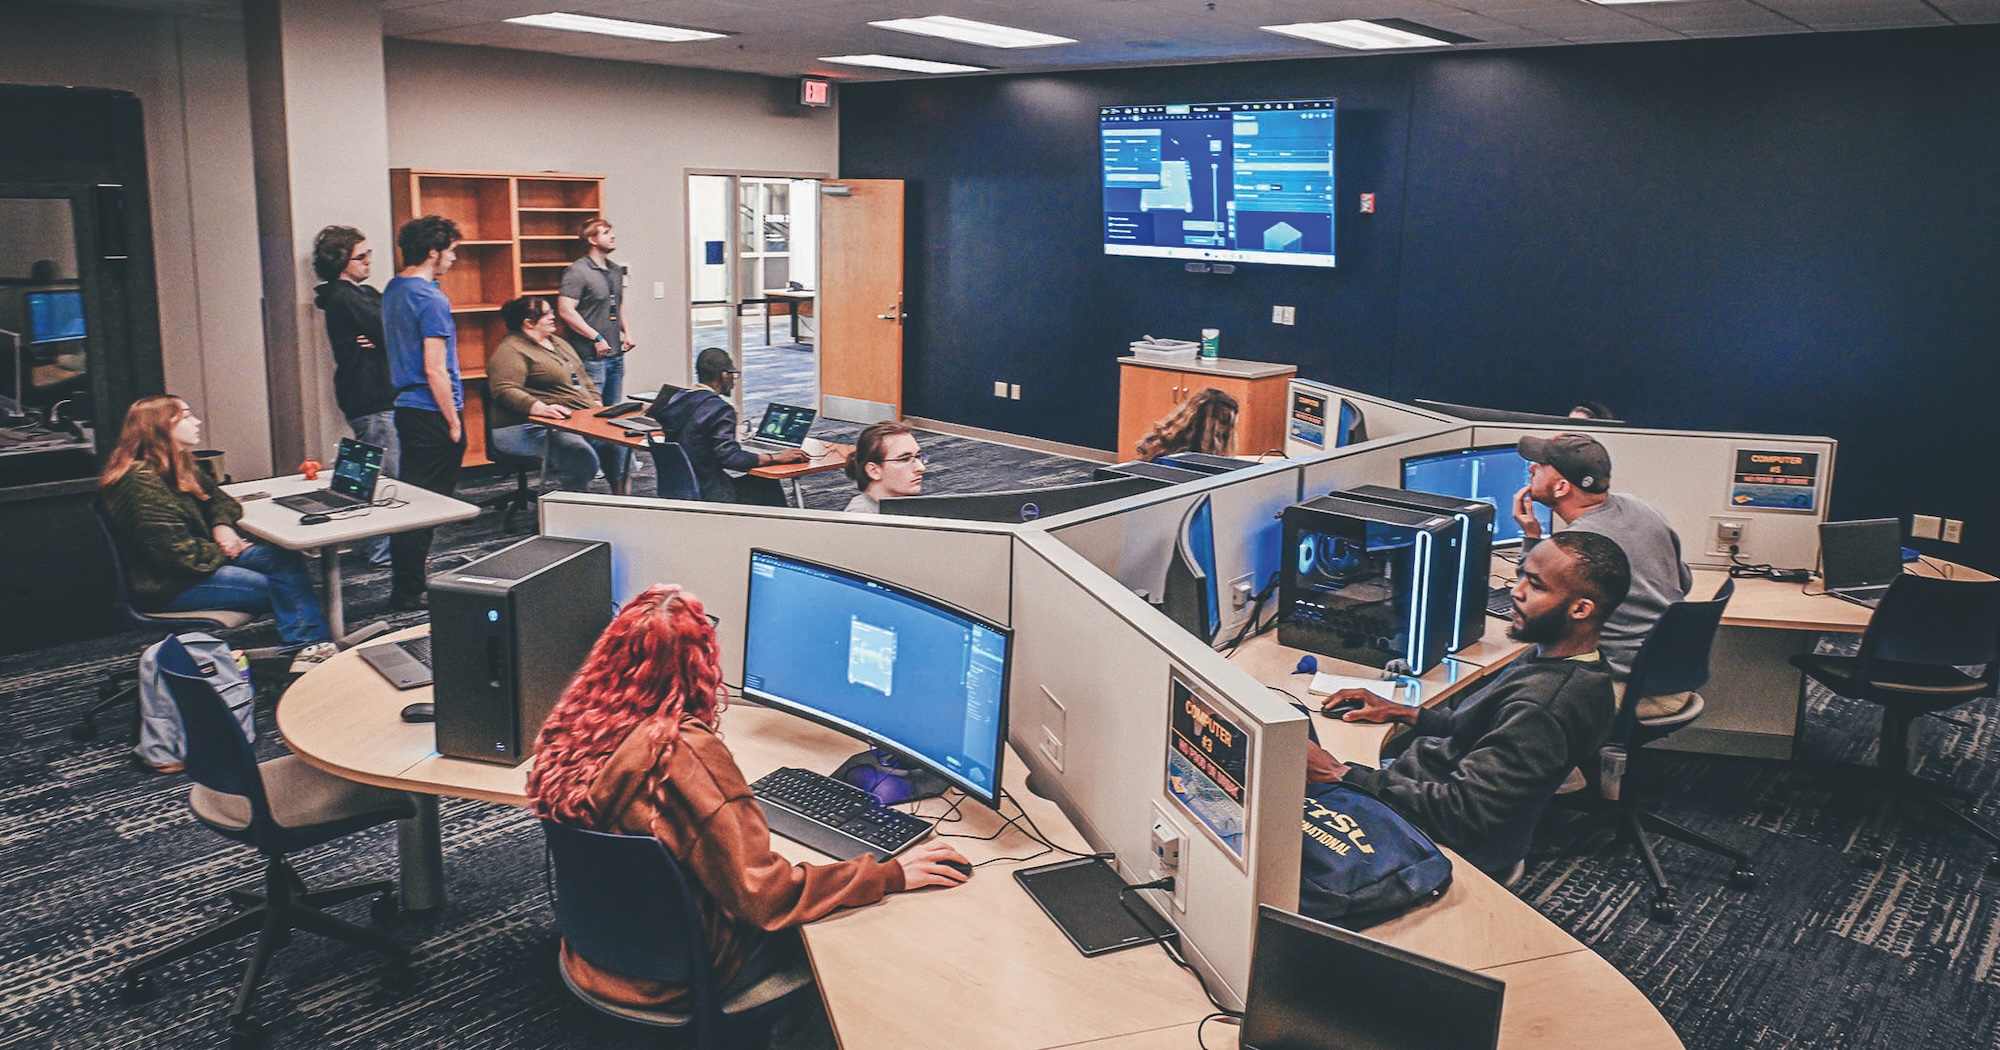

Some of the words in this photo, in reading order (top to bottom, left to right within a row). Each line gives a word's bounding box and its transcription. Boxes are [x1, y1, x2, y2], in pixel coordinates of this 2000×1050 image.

[1185, 700, 1232, 748] COMPUTER
[1201, 735, 1213, 753] #3
[1301, 819, 1351, 856] NATIONAL
